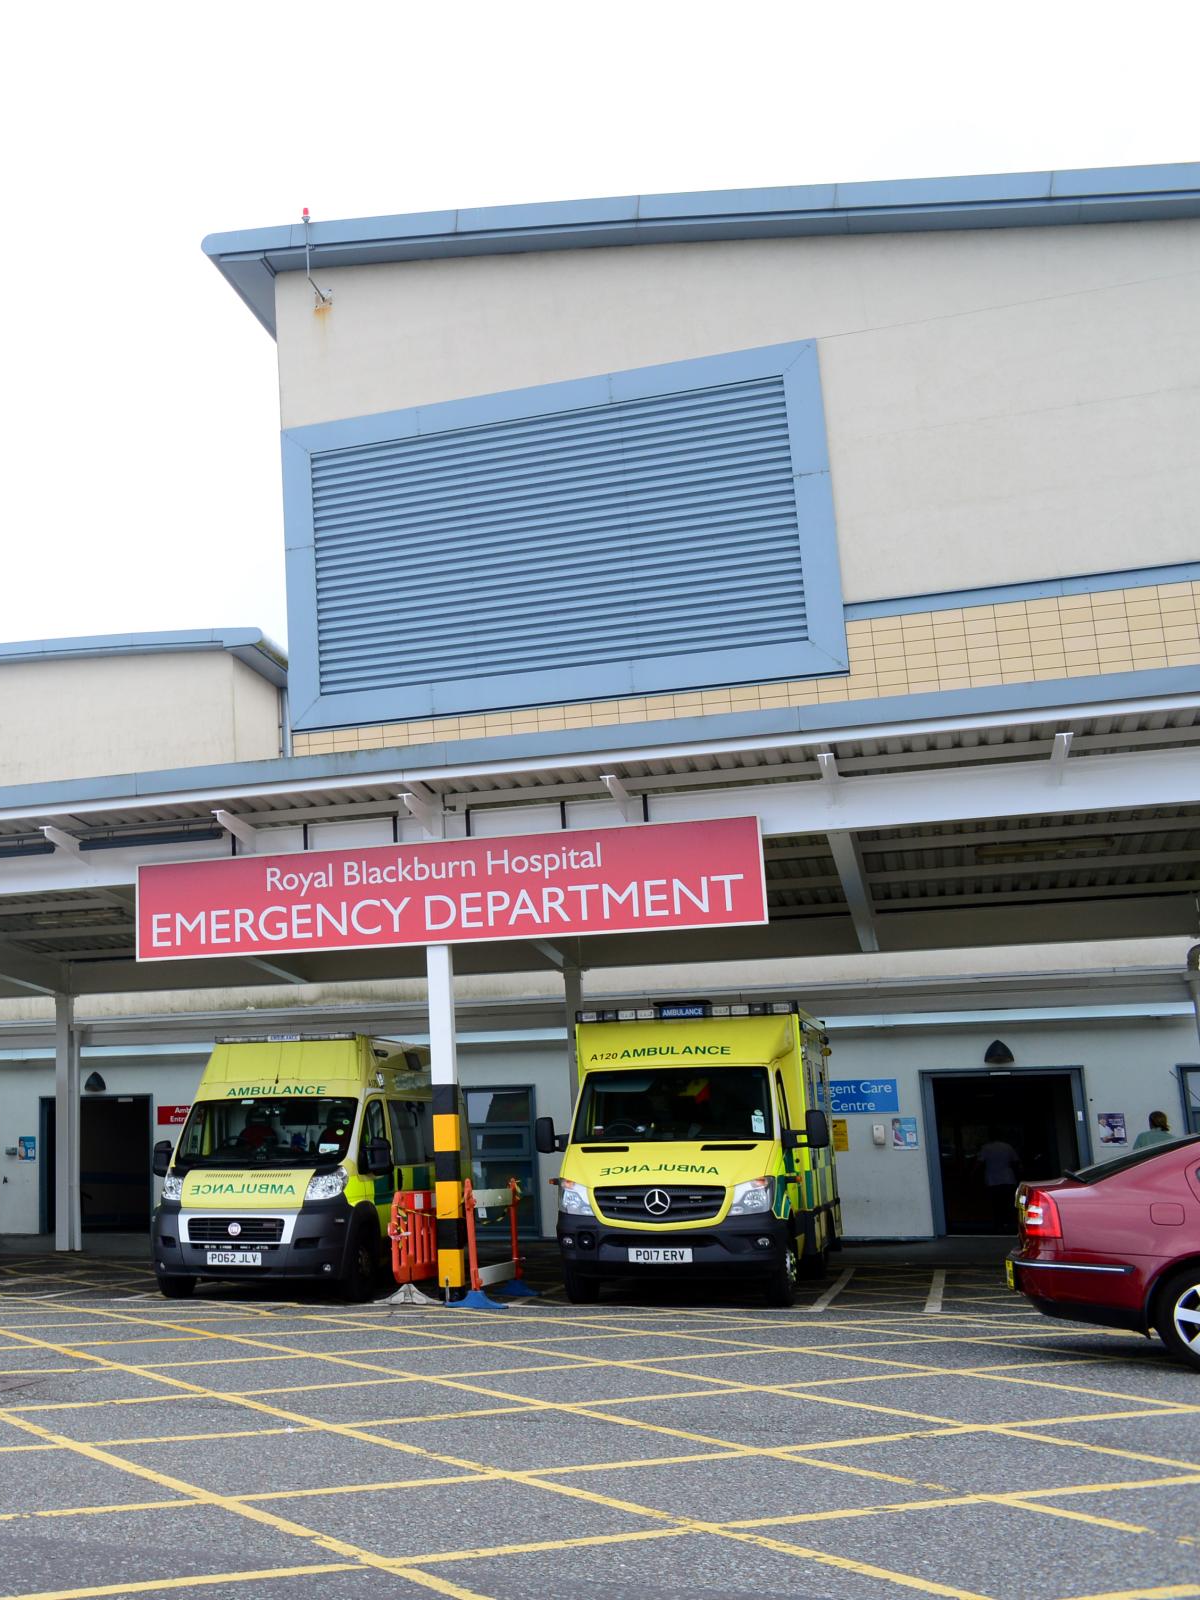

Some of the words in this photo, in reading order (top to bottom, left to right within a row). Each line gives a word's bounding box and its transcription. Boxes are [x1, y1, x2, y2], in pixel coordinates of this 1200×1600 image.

[266, 863, 333, 897] Royal
[343, 856, 476, 887] Blackburn
[487, 842, 602, 879] Hospital
[151, 896, 411, 948] EMERGENCY
[424, 873, 744, 931] DEPARTMENT
[662, 1008, 703, 1017] AMBULANCE
[590, 1052, 618, 1062] A120
[620, 1045, 731, 1060] AMBULANCE
[226, 1085, 327, 1097] AMBULANCE
[830, 1085, 856, 1098] gent
[860, 1081, 893, 1094] Care
[831, 1099, 876, 1112] Centre
[211, 1254, 236, 1263] PO62
[238, 1254, 258, 1263] JLV
[635, 1250, 660, 1261] PO17
[663, 1250, 685, 1261] ERV
